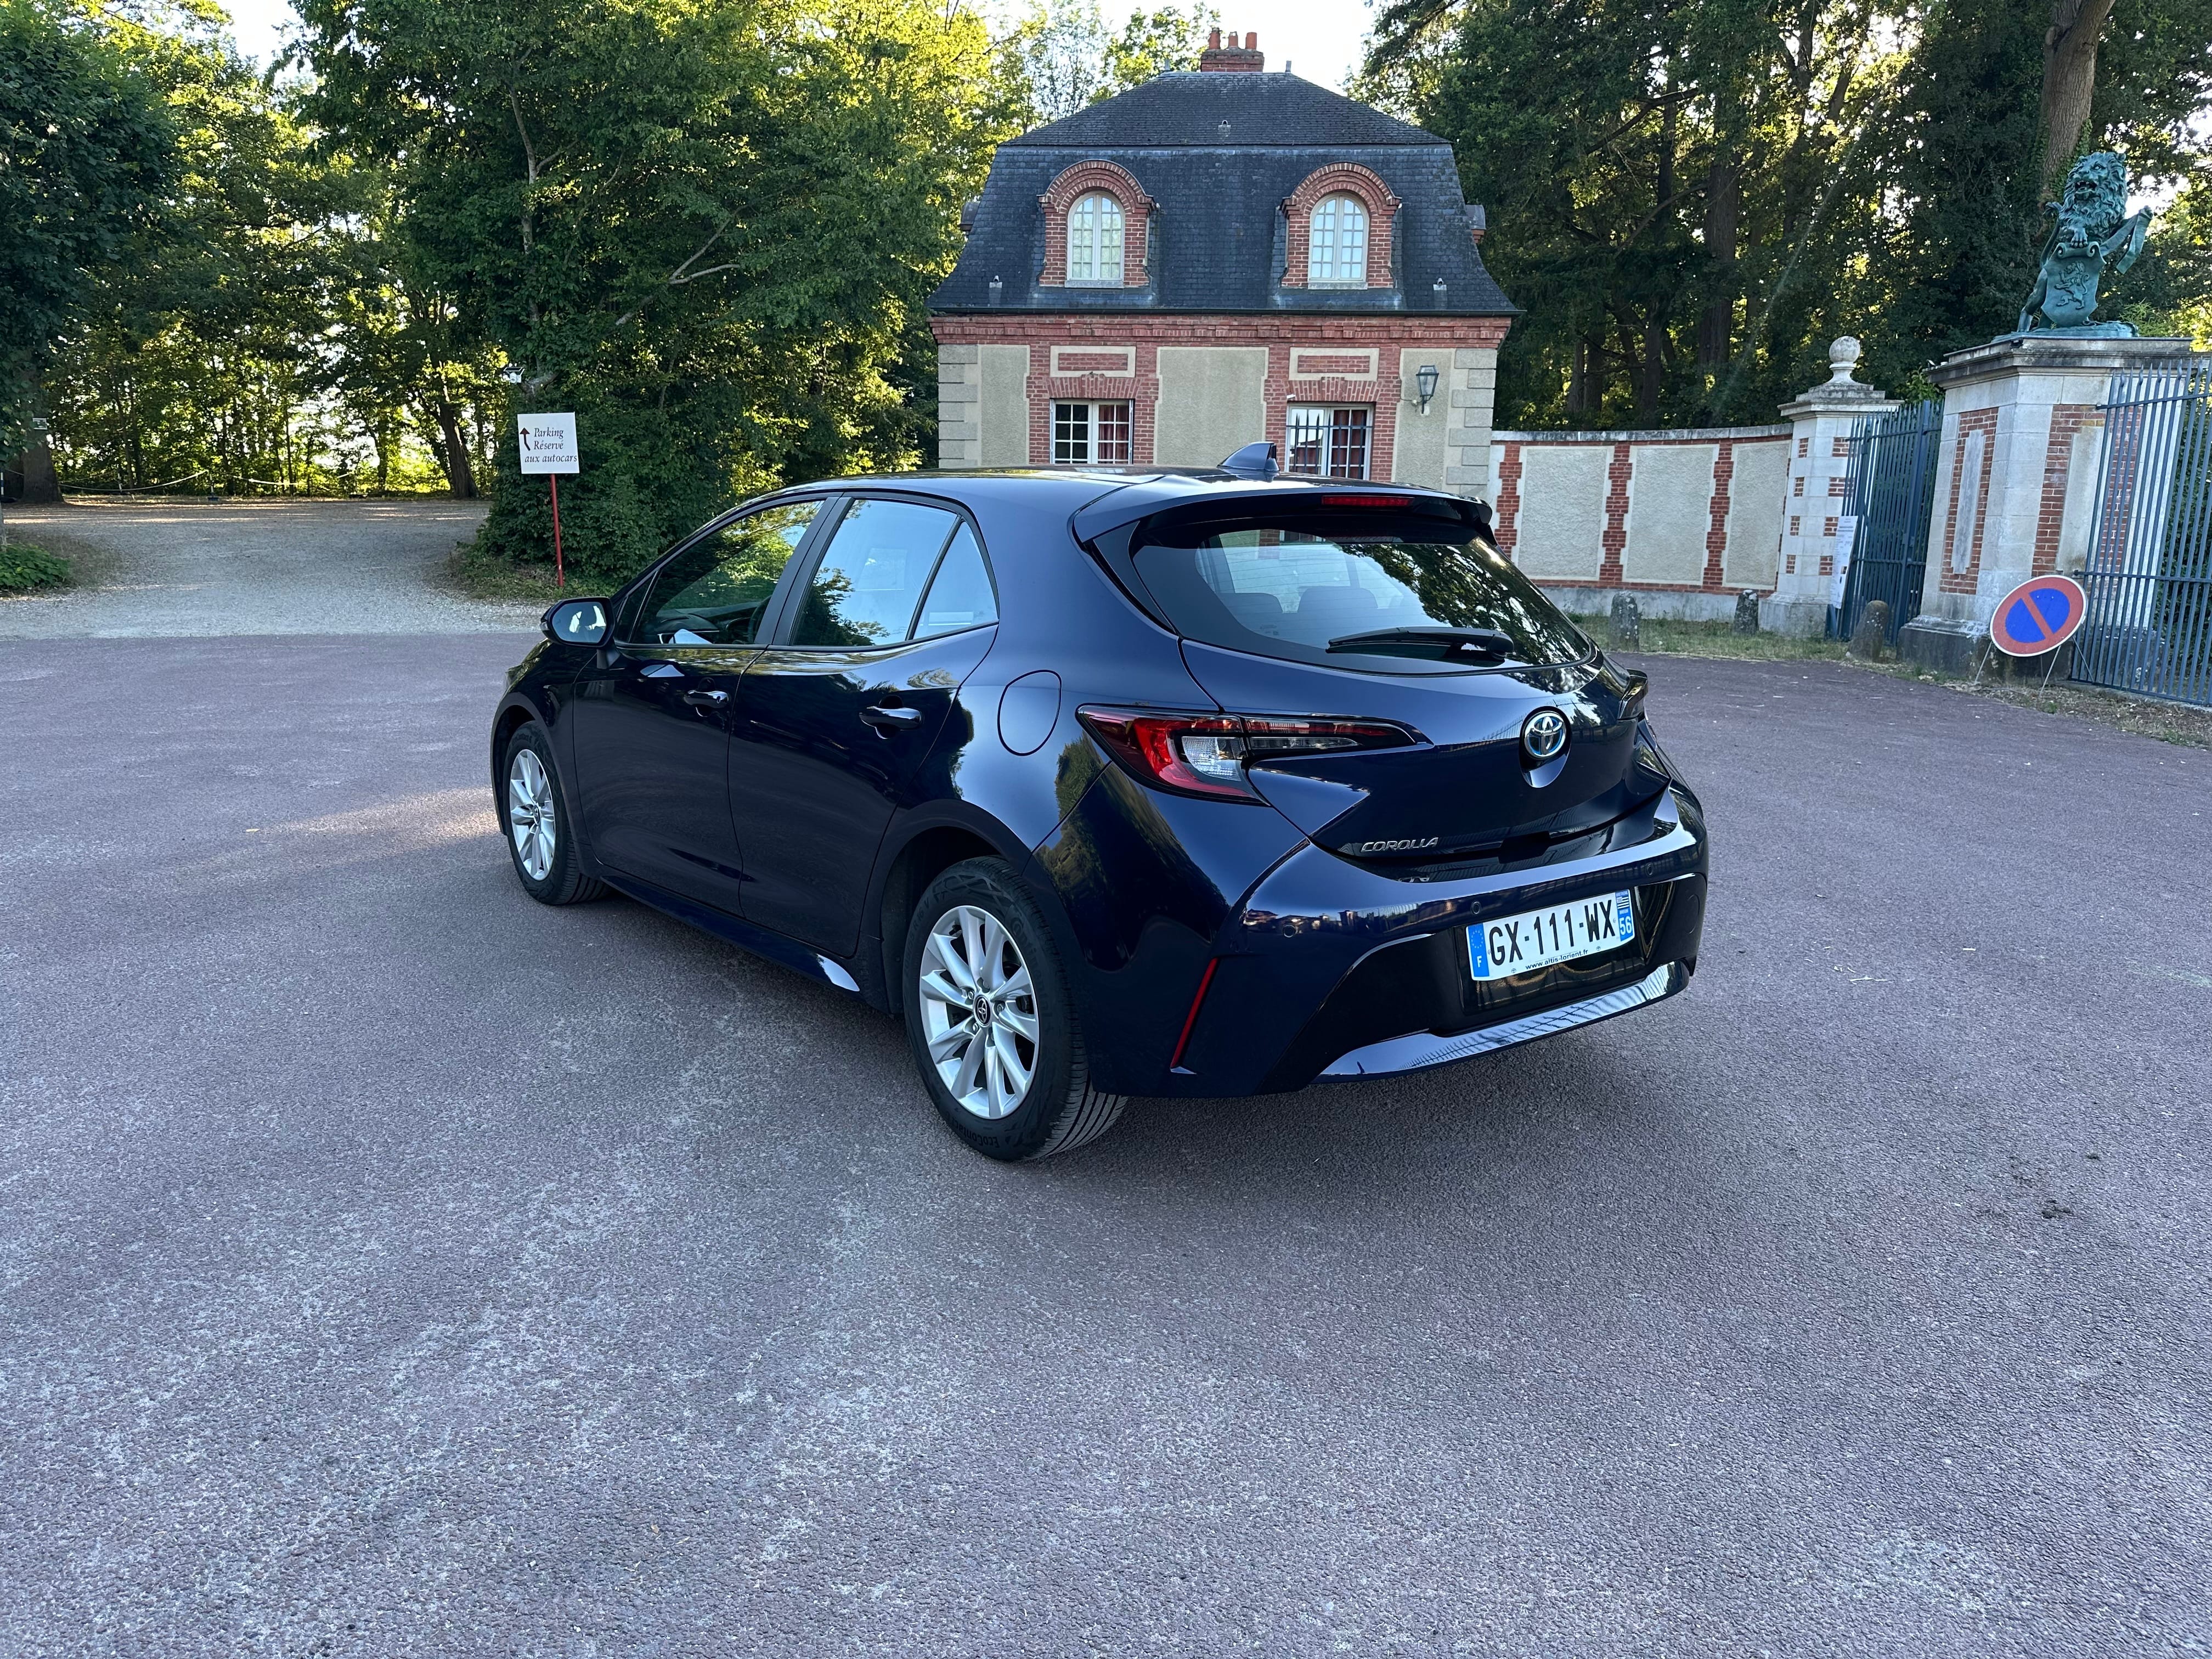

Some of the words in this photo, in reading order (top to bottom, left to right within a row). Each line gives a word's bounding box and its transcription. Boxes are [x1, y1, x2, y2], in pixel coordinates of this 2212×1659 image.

[534, 427, 564, 439] Parking
[534, 440, 564, 450] Réservé
[1361, 837, 1438, 853] COROLLA
[1619, 916, 1632, 935] 56
[1476, 955, 1482, 968] F
[1525, 949, 1588, 970] www.altis-lorient.fr
